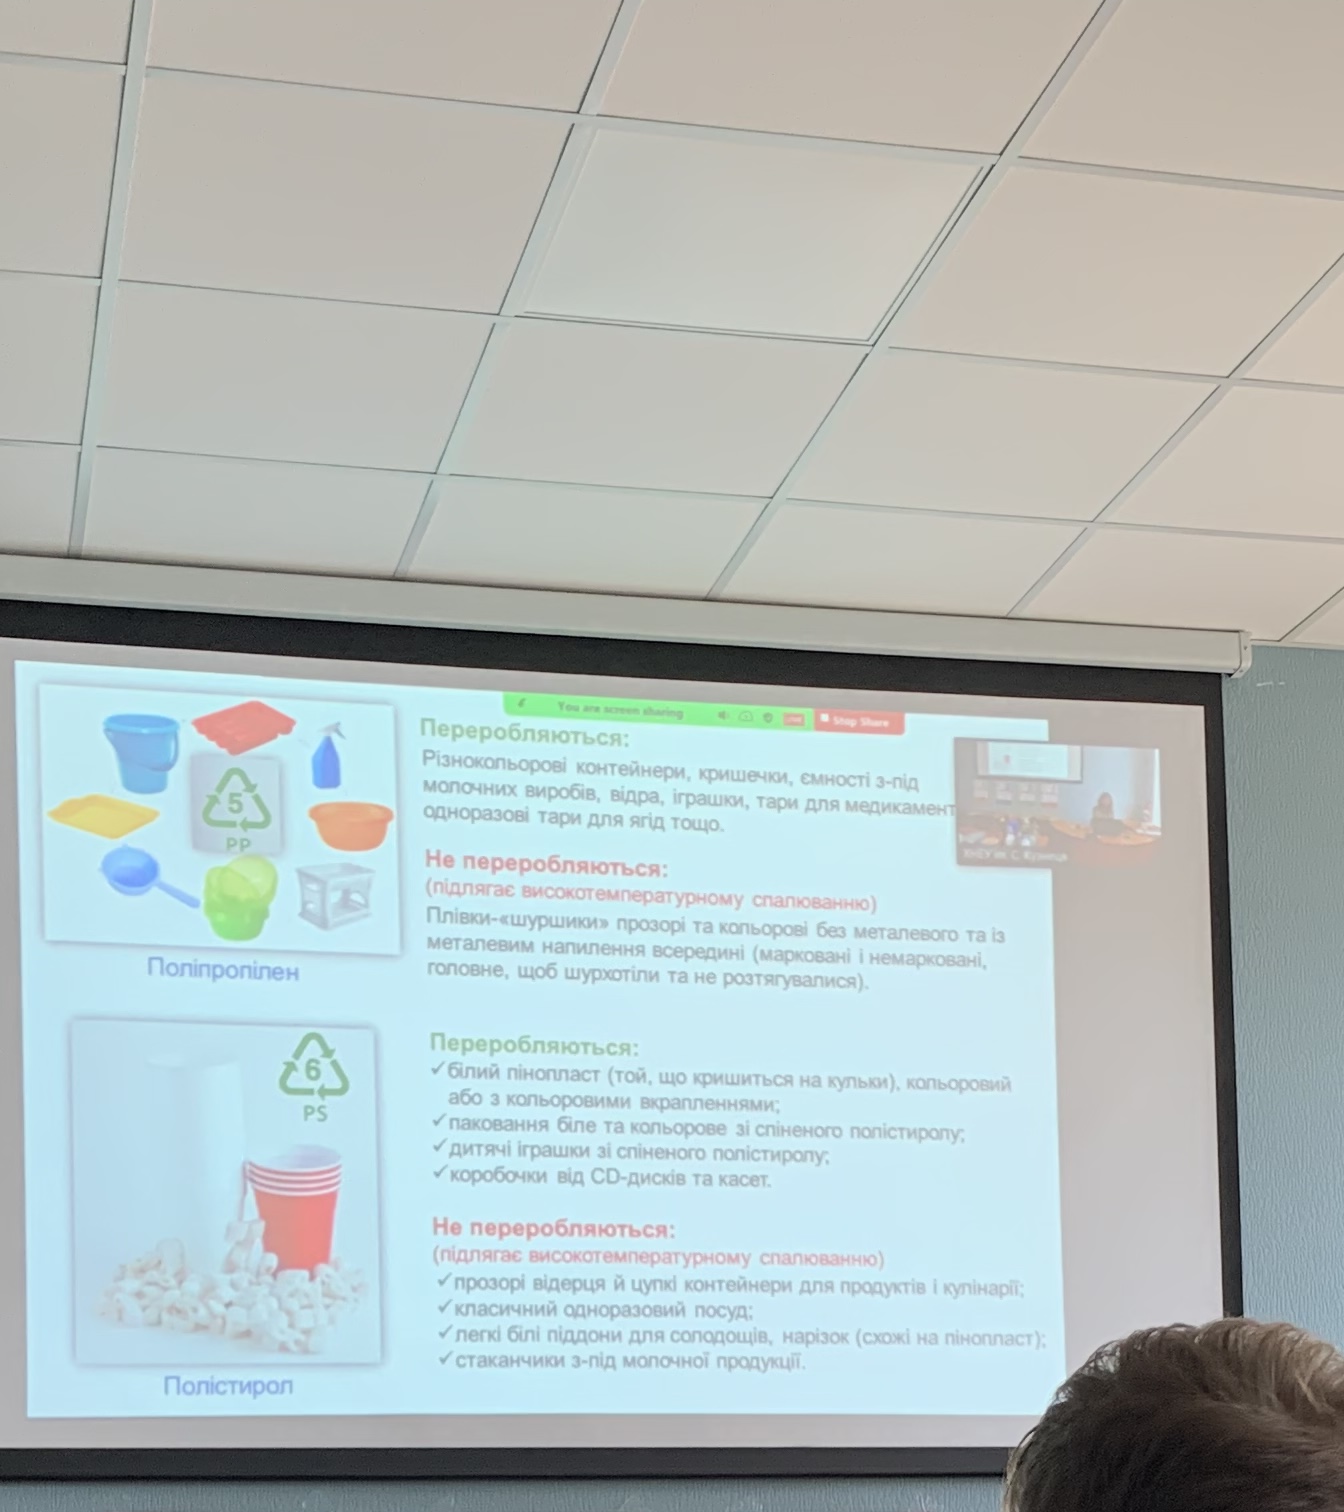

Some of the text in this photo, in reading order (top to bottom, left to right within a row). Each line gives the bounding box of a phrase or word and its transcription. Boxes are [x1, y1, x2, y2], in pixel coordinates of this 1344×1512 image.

[422, 750, 567, 777] Різнокольорові
[799, 771, 871, 789] ємності
[875, 772, 920, 794] з-під
[228, 793, 243, 814] 5
[422, 779, 518, 797] молочних
[755, 795, 799, 814] тари
[804, 797, 841, 815] для
[422, 804, 725, 835] одноразові тари для ягід тощо.
[226, 837, 251, 852] PP
[425, 848, 456, 870] Не
[425, 876, 516, 898] (підлягає
[751, 893, 878, 915] спалюванню)
[616, 916, 686, 937] прозорі
[692, 920, 714, 935] та
[718, 920, 809, 941] кольорові
[815, 920, 847, 940] без
[853, 925, 960, 943] металевого
[965, 929, 987, 943] та
[991, 927, 1006, 944] із
[426, 935, 535, 954] металевим
[541, 940, 646, 958] напилення
[651, 943, 745, 963] всередині
[751, 943, 852, 966] (марковані
[858, 947, 864, 964] і
[147, 957, 299, 984] Поліпропілен
[517, 961, 559, 982] щоб
[563, 965, 660, 986] шурхотіли
[666, 970, 689, 984] та
[693, 971, 718, 985] не
[305, 1059, 321, 1081] 6
[448, 1060, 501, 1081] білий
[506, 1062, 602, 1083] пінопласт
[658, 1071, 688, 1088] що
[692, 1071, 794, 1089] кришиться
[799, 1074, 823, 1089] на
[906, 1075, 1012, 1095] кольоровий
[447, 1087, 484, 1107] або
[490, 1092, 501, 1107] з
[505, 1093, 632, 1112] кольоровими
[303, 1106, 327, 1121] PS
[449, 1116, 550, 1133] паковання
[556, 1114, 598, 1135] біле
[602, 1120, 625, 1135] та
[629, 1121, 728, 1140] кольорове
[735, 1119, 751, 1138] зі
[754, 1119, 844, 1139] спіненого
[449, 1139, 512, 1160] дитячі
[517, 1139, 591, 1163] іграшки
[596, 1142, 612, 1160] зі
[615, 1142, 707, 1162] спіненого
[450, 1164, 772, 1189] коробочки від CD-дисків та касет.
[432, 1216, 463, 1237] Не
[432, 1244, 523, 1267] (підлягає
[758, 1249, 885, 1270] спалюванню)
[454, 1271, 526, 1296] прозорі
[532, 1273, 606, 1296] відерця
[613, 1273, 626, 1293] й
[630, 1274, 678, 1297] цупкі
[684, 1275, 793, 1298] контейнери
[798, 1279, 835, 1297] для
[839, 1277, 927, 1299] продуктів
[932, 1278, 938, 1295] і
[454, 1298, 558, 1318] класичний
[562, 1300, 687, 1322] одноразовий
[455, 1324, 502, 1344] легкі
[506, 1324, 541, 1344] білі
[546, 1324, 623, 1346] піддони
[627, 1329, 666, 1347] для
[782, 1327, 850, 1348] нарізок
[855, 1327, 911, 1349] (схожі
[916, 1332, 939, 1346] на
[456, 1350, 806, 1374] стаканчики з-під молочної продукції.
[164, 1376, 293, 1399] Полістирол
